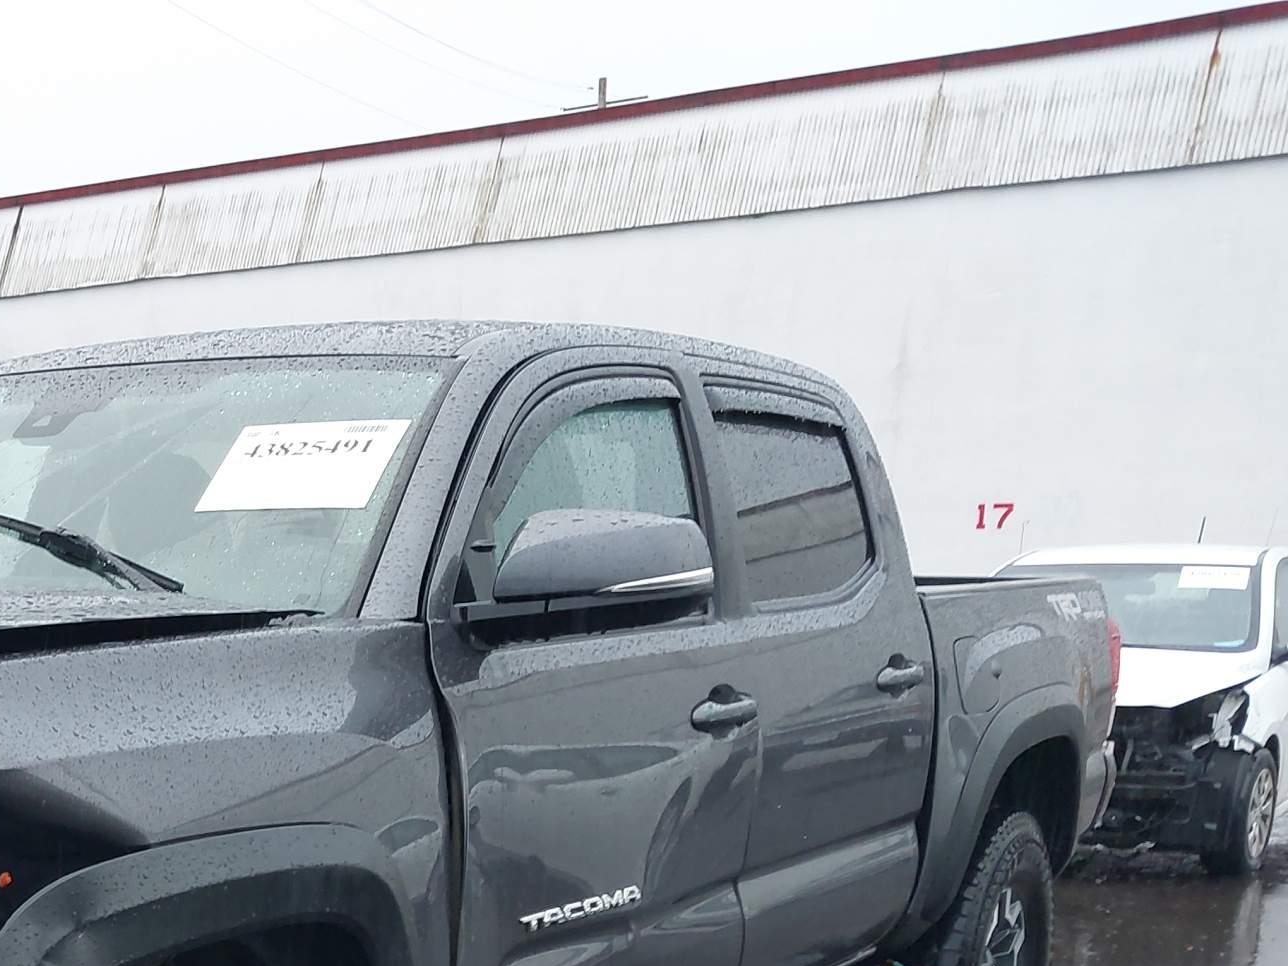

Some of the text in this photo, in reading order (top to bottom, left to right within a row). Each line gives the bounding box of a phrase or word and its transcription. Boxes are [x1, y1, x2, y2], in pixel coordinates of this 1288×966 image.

[244, 439, 373, 458] 43825491
[975, 502, 1015, 530] 17
[519, 884, 642, 931] TACOMA
